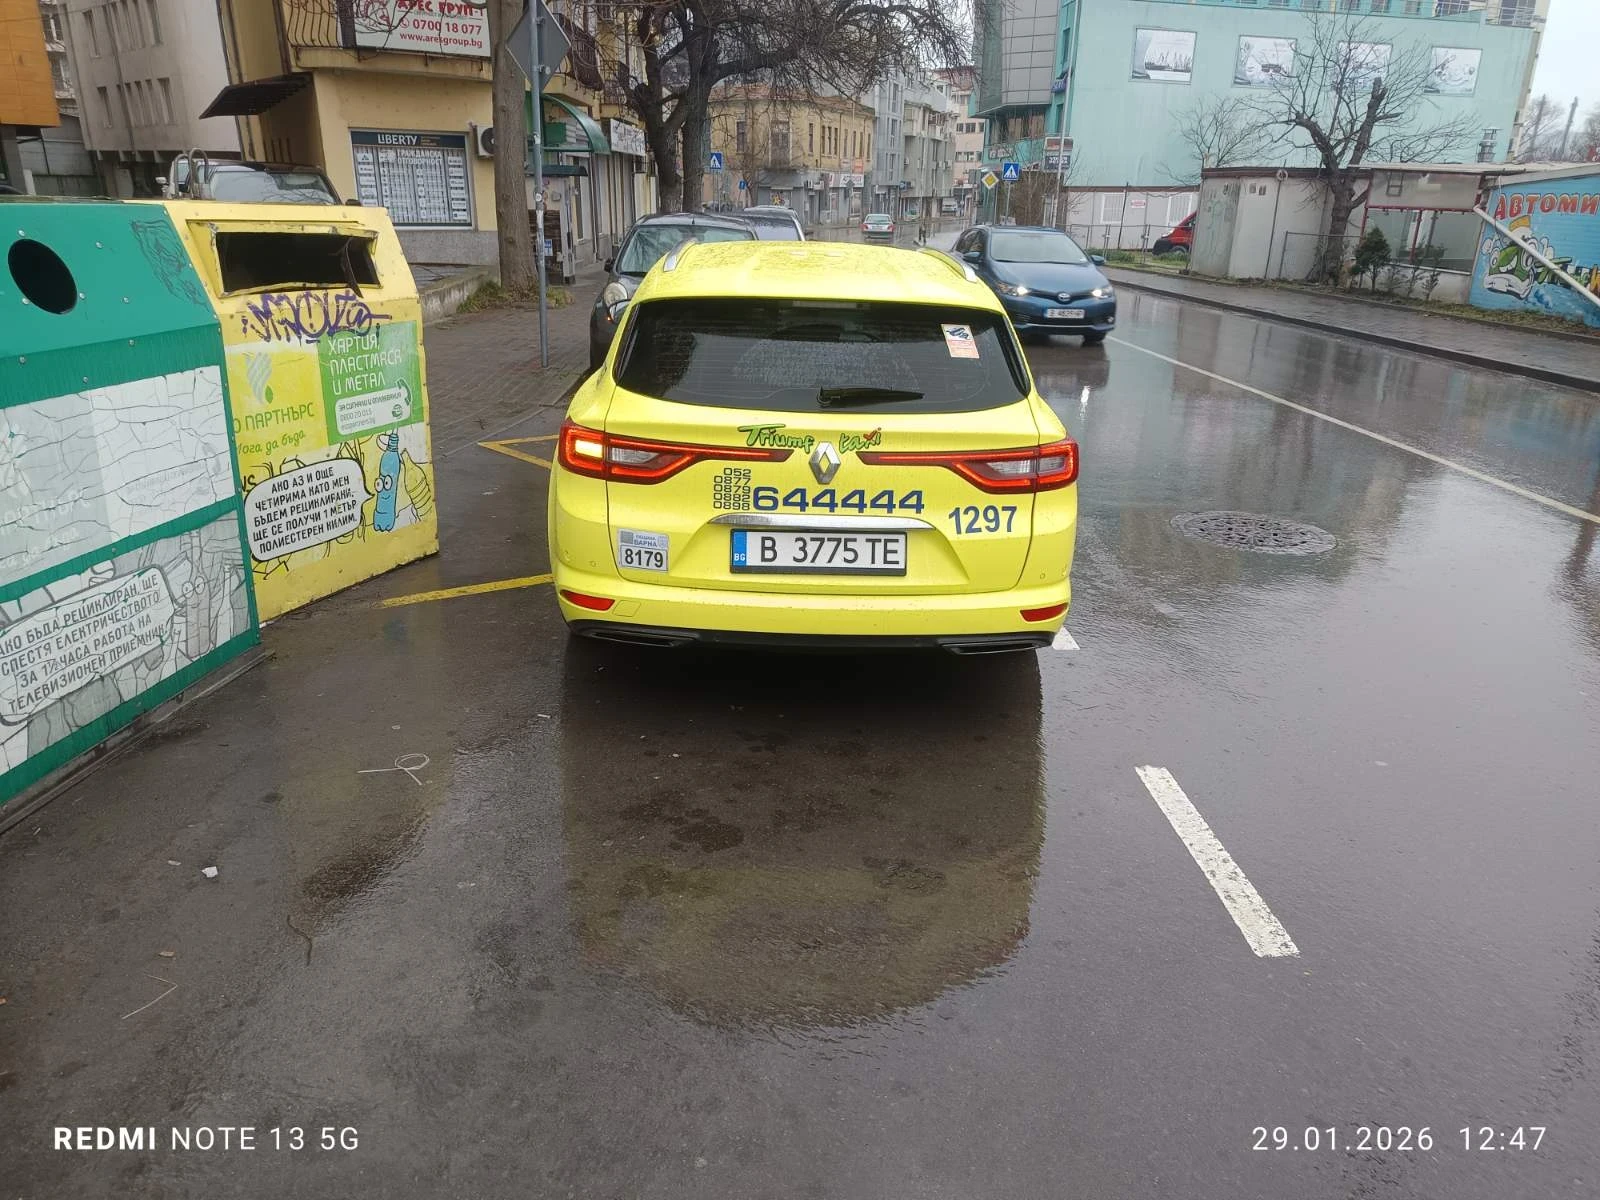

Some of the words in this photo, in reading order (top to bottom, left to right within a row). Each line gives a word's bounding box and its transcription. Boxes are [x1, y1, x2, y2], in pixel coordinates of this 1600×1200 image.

[412, 19, 441, 31] 0700
[445, 22, 458, 33] 18
[461, 24, 482, 35] 077
[377, 133, 418, 145] LIBERTY
[1494, 192, 1600, 220] АВТОМИ
[328, 334, 380, 355] ХАРТИЯ,
[330, 349, 402, 376] ПЛАСТМАСА
[333, 379, 342, 395] И
[345, 371, 386, 392] МЕТАЛ
[245, 402, 315, 431] ПАРТНЪРС
[266, 440, 279, 456] да
[281, 430, 306, 446] бъда
[737, 424, 814, 454] Triumf
[839, 427, 882, 452] taxi
[271, 479, 289, 494] АКО
[292, 475, 305, 488] АЗ
[306, 472, 313, 484] И
[315, 467, 334, 481] ОЩЕ
[714, 475, 752, 485] 0877
[723, 467, 752, 477] 052
[255, 489, 306, 511] ЧЕТИРИМА
[309, 481, 330, 496] КАТО
[332, 475, 350, 489] МЕН
[713, 484, 751, 494] 0879
[713, 492, 751, 502] 0882
[753, 486, 925, 514] 644444
[254, 508, 288, 527] БЪДЕМ
[713, 501, 750, 511] 0898
[253, 528, 268, 542] ЩЕ
[271, 523, 283, 536] СЕ
[286, 511, 321, 531] ПОЛУЧИ
[323, 509, 328, 519] 1
[330, 499, 357, 517] МЕТЪР
[948, 505, 1018, 535] 1297
[259, 523, 324, 554] ПОЛИЕСТЕРЕН
[733, 553, 746, 562] BG
[760, 536, 778, 563] B
[792, 537, 859, 564] 3775
[866, 538, 900, 565] TE
[624, 548, 664, 568] 8179
[63, 583, 140, 627] РЕЦИКЛИРАН,
[142, 574, 158, 590] ЩЕ
[1, 642, 51, 676] СПЕСТЯ
[56, 591, 160, 650] ЕЛЕКТРИЧЕСТВОТО
[20, 670, 38, 688] ЗА
[60, 644, 91, 666] ЧАСА
[94, 621, 136, 651] РАБОТА
[138, 613, 152, 629] НА
[8, 657, 106, 713] ТЕЛЕВИЗИОНЕН
